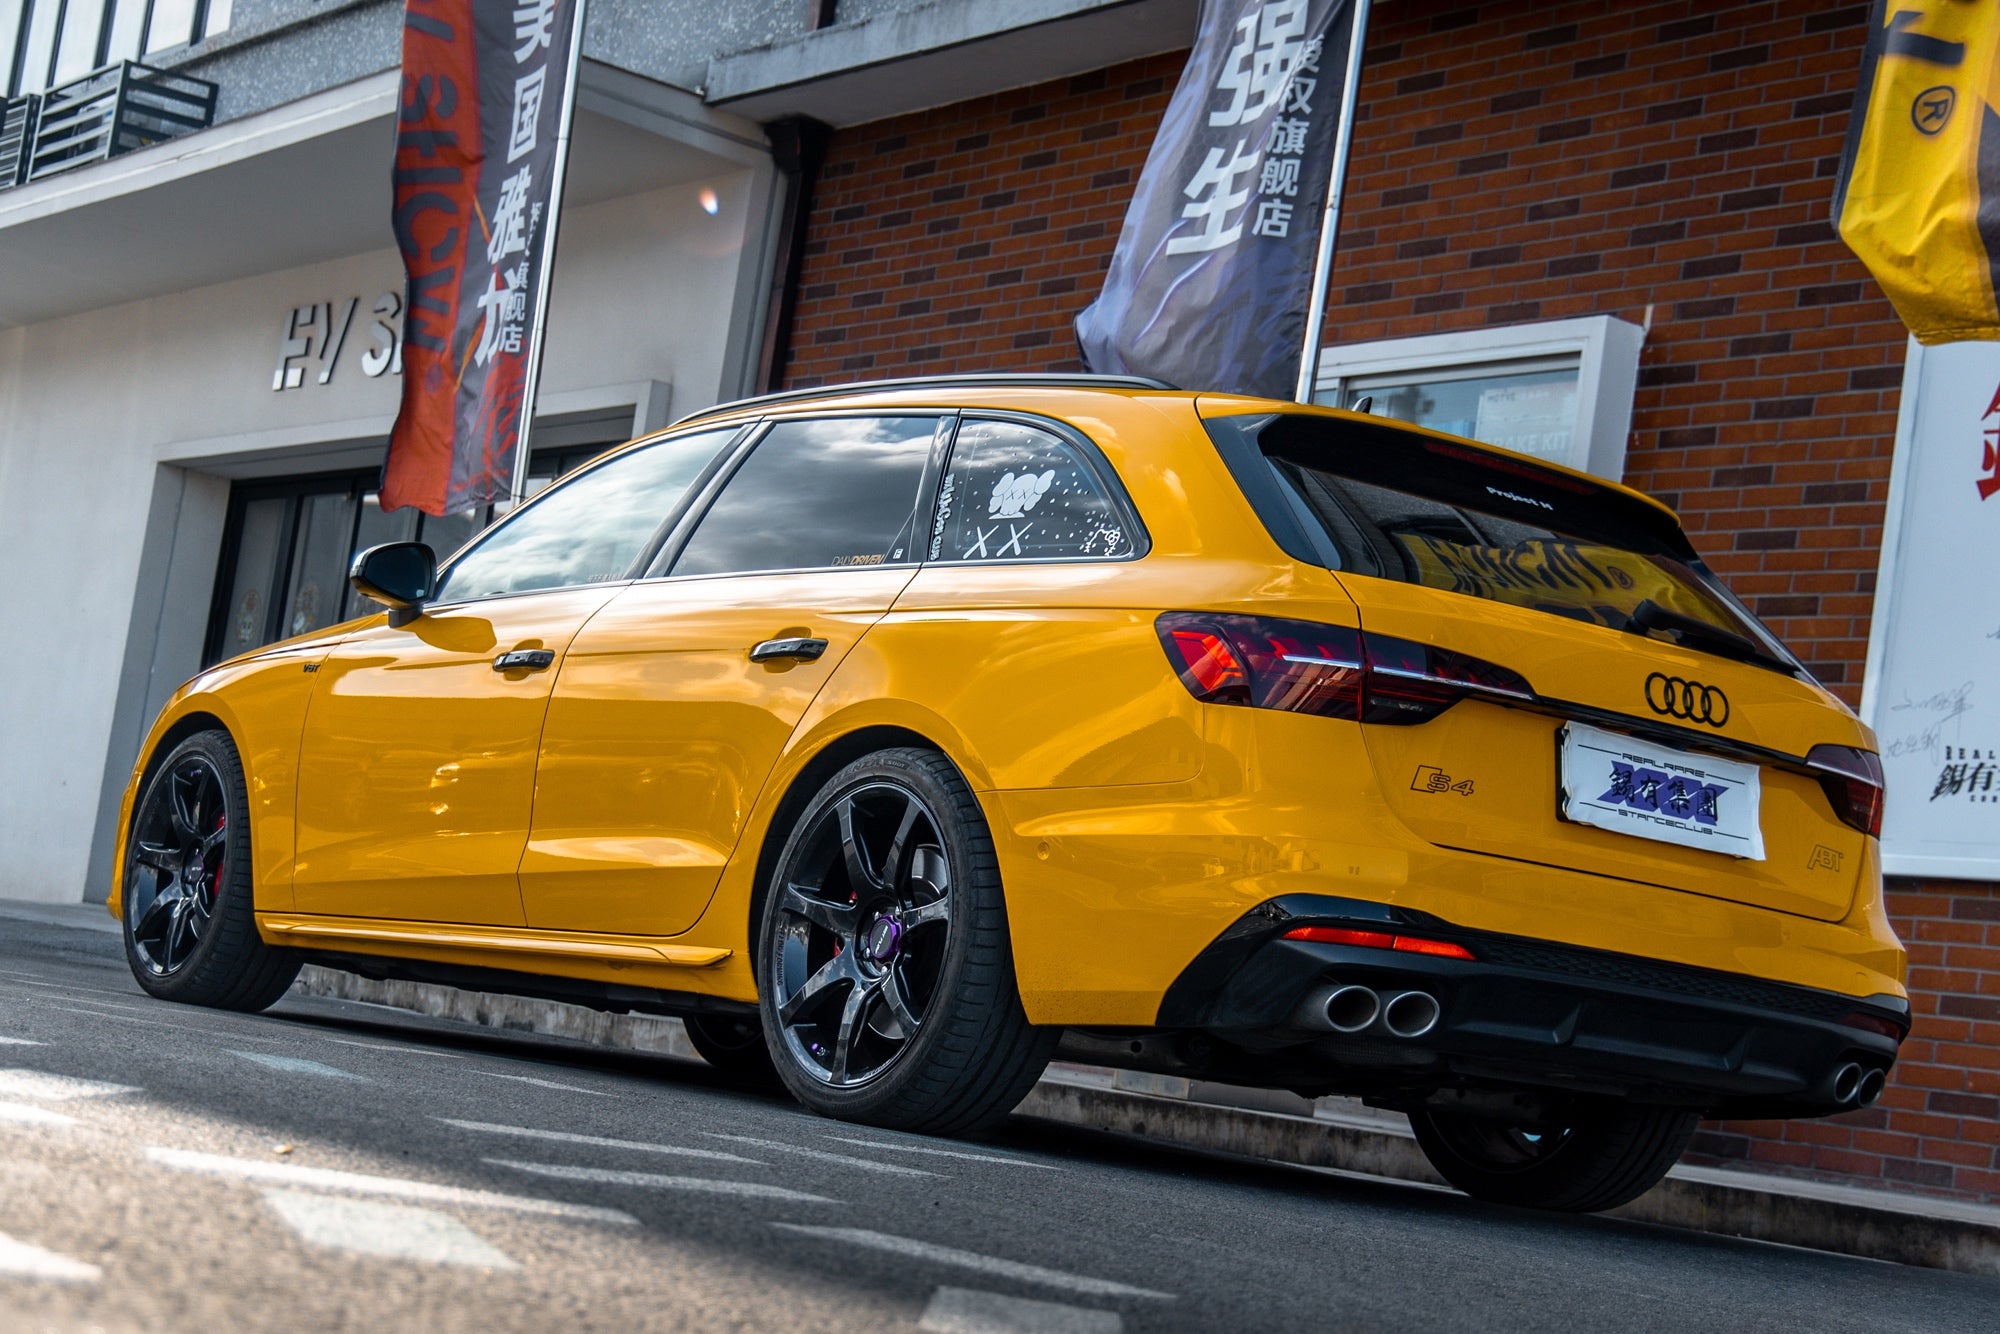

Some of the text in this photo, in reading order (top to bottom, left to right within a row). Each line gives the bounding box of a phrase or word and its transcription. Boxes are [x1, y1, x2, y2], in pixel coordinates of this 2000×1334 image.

[361, 291, 403, 378] S
[1621, 752, 1706, 778] REALRARE
[1425, 771, 1475, 797] S4
